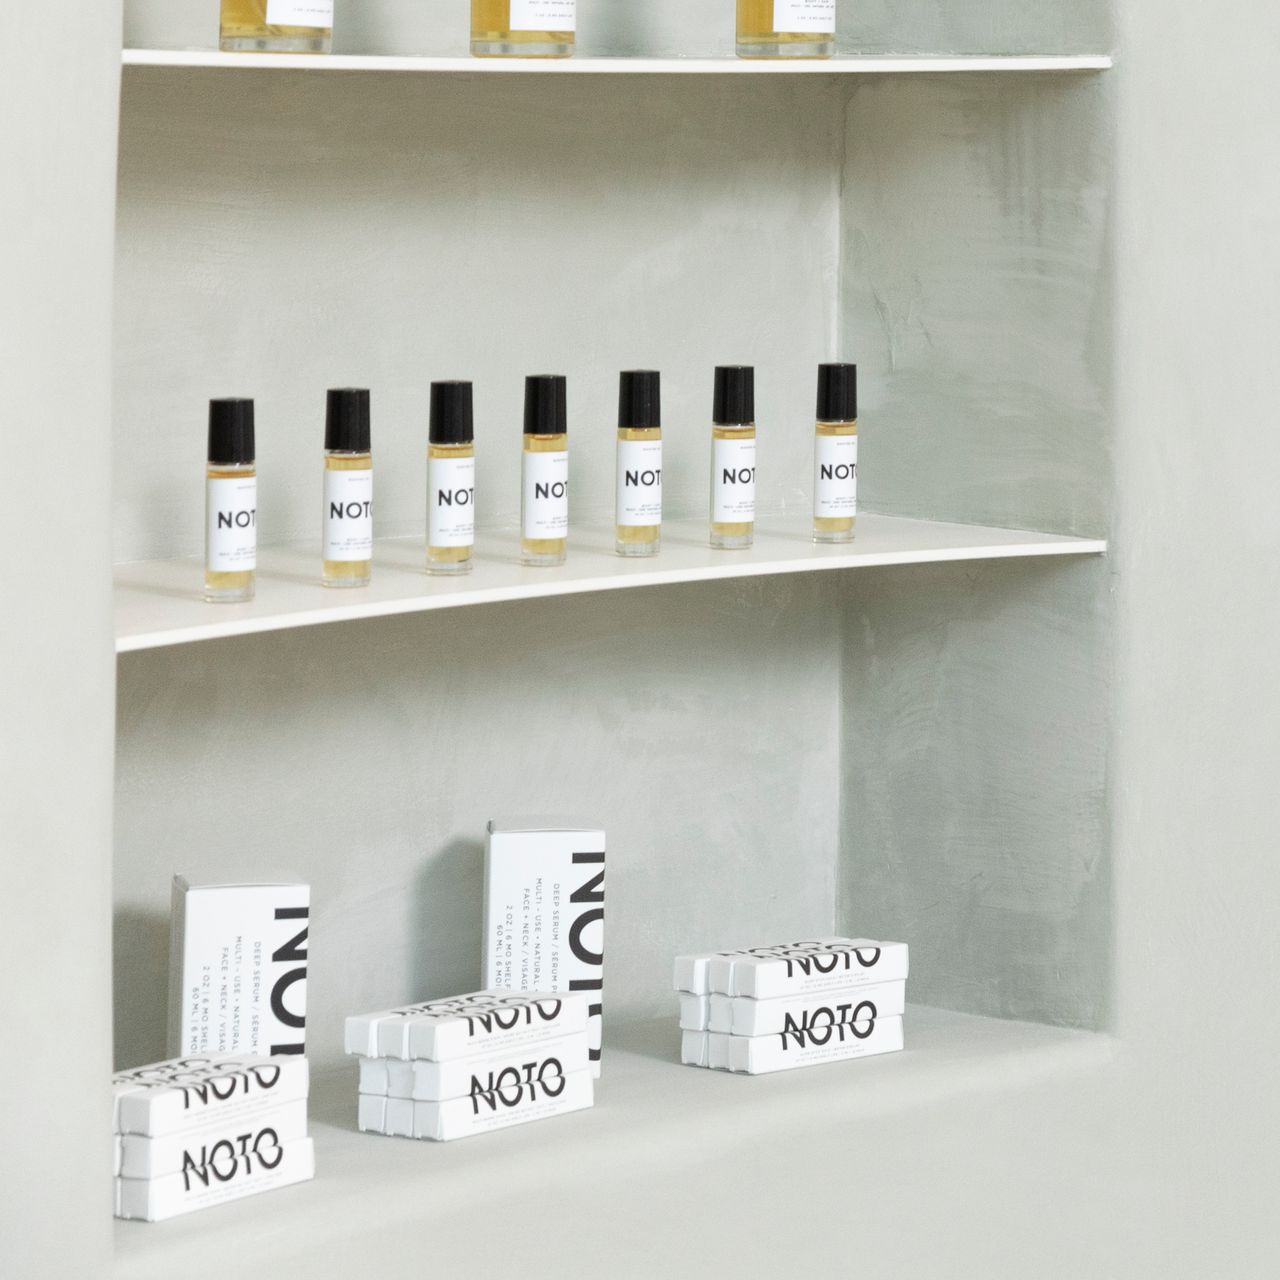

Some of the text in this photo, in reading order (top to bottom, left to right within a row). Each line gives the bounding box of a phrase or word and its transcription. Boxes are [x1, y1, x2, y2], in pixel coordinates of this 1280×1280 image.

[626, 470, 661, 486] NOT
[723, 467, 755, 484] NOT
[820, 464, 857, 480] NOT
[438, 488, 473, 506] NOT
[218, 509, 255, 528] NOT
[330, 501, 373, 519] NOT
[535, 878, 543, 905] MULTI
[505, 913, 513, 926] OZ
[552, 910, 560, 941] SERUM
[253, 941, 261, 967] DEEP
[496, 940, 503, 952] ML
[505, 944, 512, 958] MO
[221, 947, 229, 971] FACE
[202, 975, 210, 988] OZ
[252, 970, 260, 1003] SERUM
[220, 984, 228, 1010] NECK
[192, 1003, 199, 1015] ML
[201, 1008, 209, 1022] MO
[251, 1015, 259, 1048] SERUM
[780, 1000, 877, 1051] NOTO
[200, 1026, 208, 1054] SHEL
[218, 1022, 226, 1052] VISAG
[469, 1057, 566, 1114] NOTO
[182, 1127, 283, 1191] NOTO
